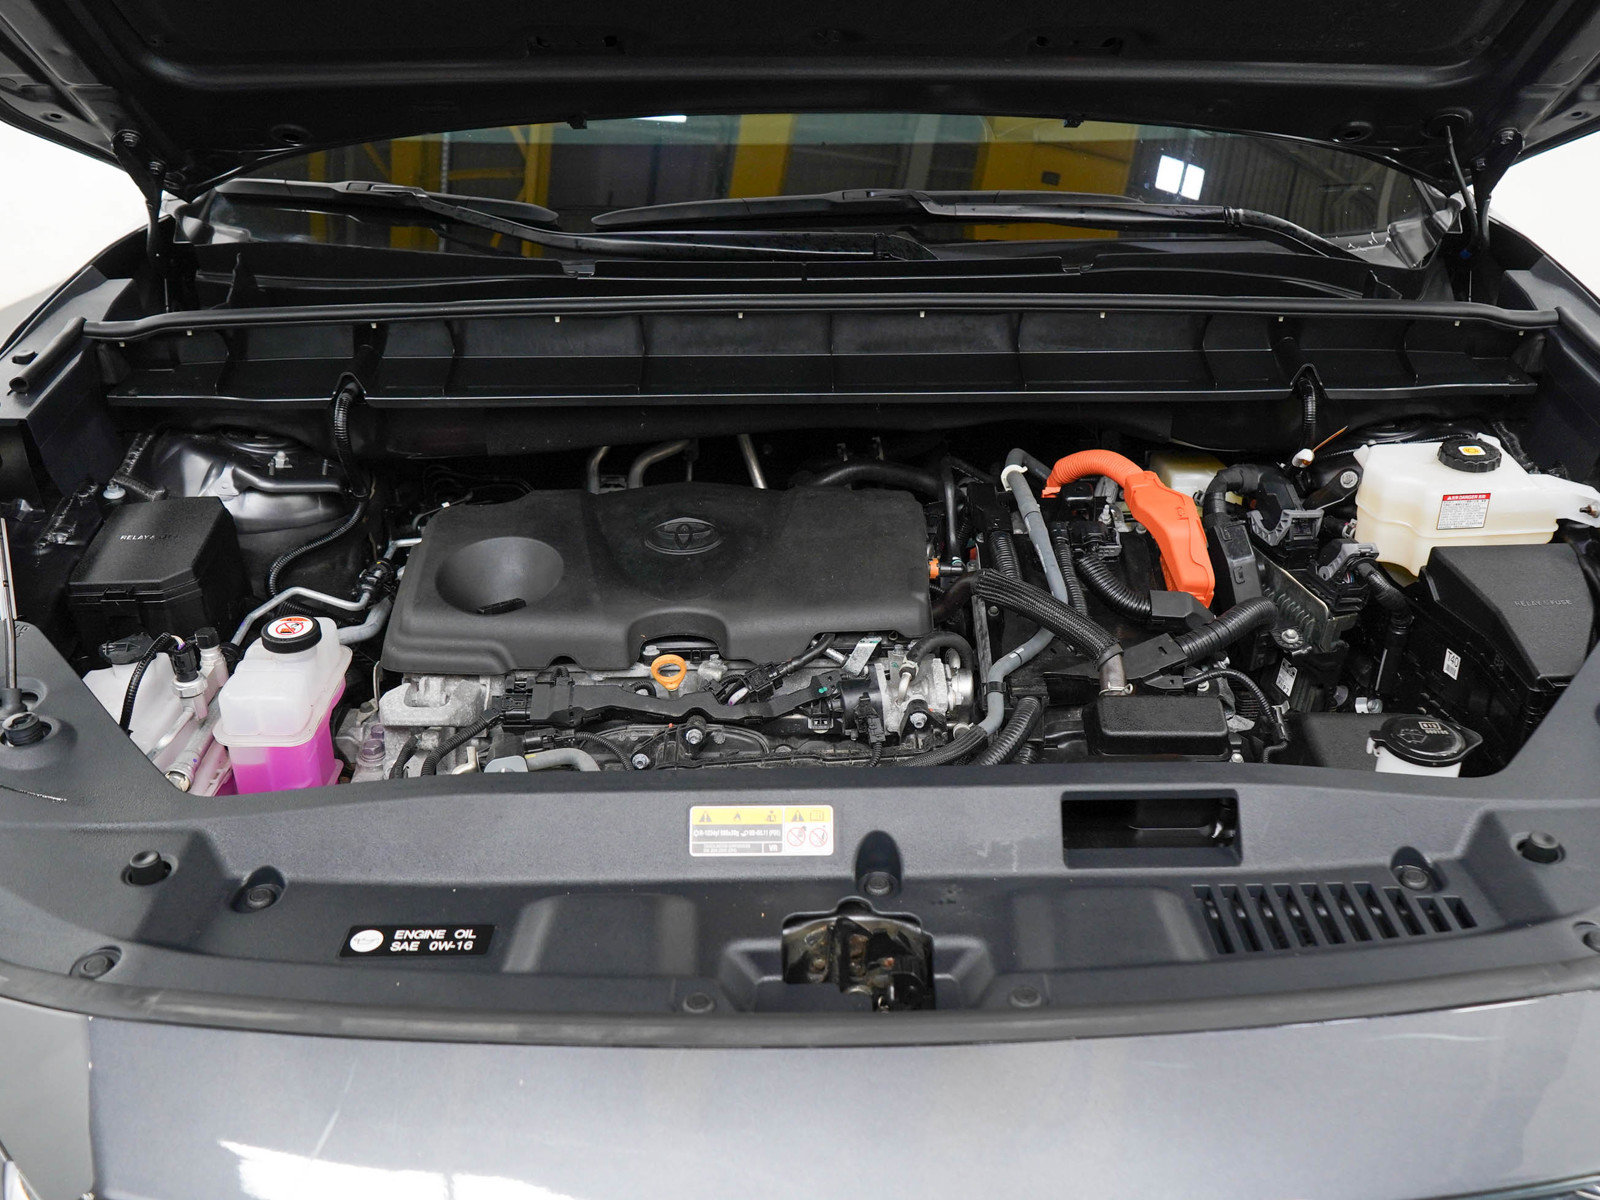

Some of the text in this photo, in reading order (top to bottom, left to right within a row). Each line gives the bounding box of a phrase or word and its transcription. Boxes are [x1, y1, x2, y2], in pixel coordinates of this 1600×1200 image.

[1447, 650, 1460, 668] T40
[393, 929, 477, 940] ENGINE OIL
[390, 940, 474, 951] SAE 0W-16
